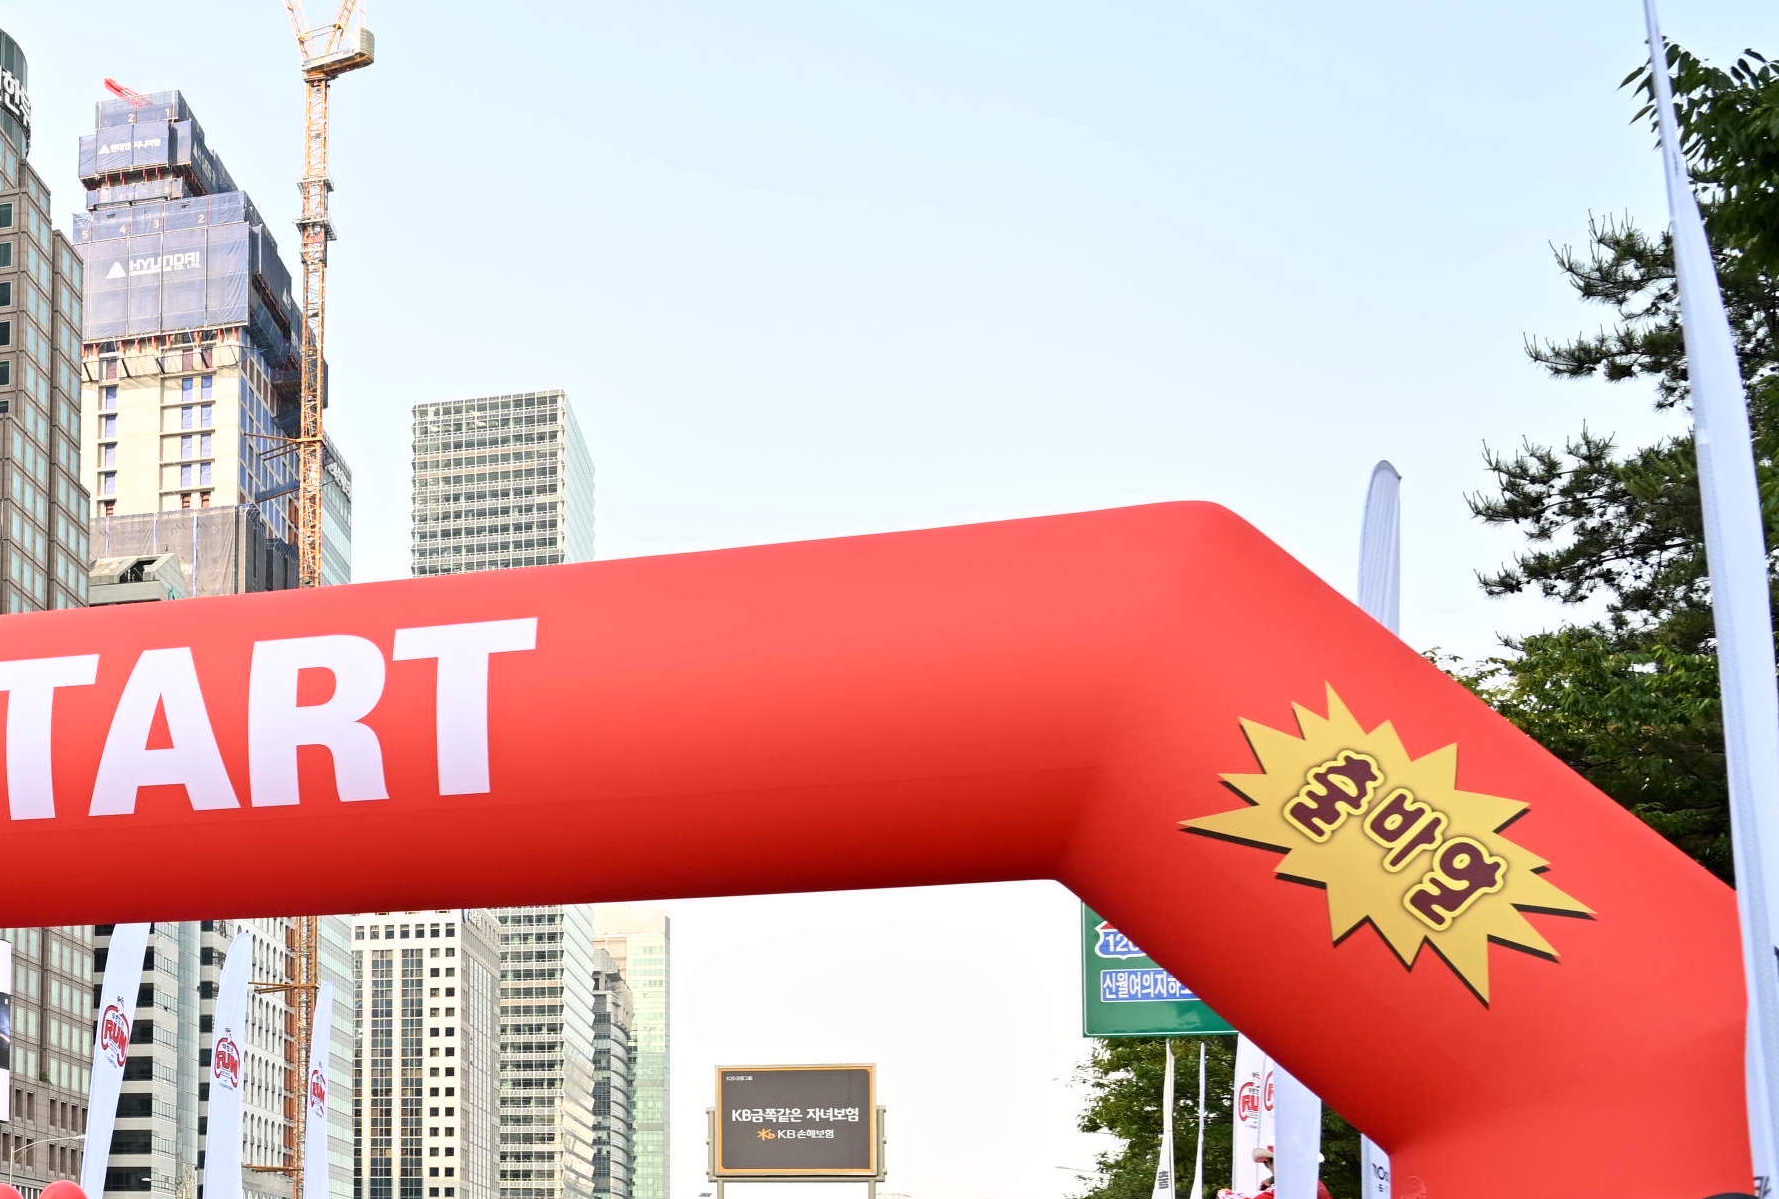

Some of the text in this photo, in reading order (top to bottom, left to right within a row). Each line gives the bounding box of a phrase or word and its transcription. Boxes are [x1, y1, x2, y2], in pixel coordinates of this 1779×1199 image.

[130, 251, 200, 272] HYUNDAI
[732, 1107, 859, 1123] KB금쪽같은 자녀보험
